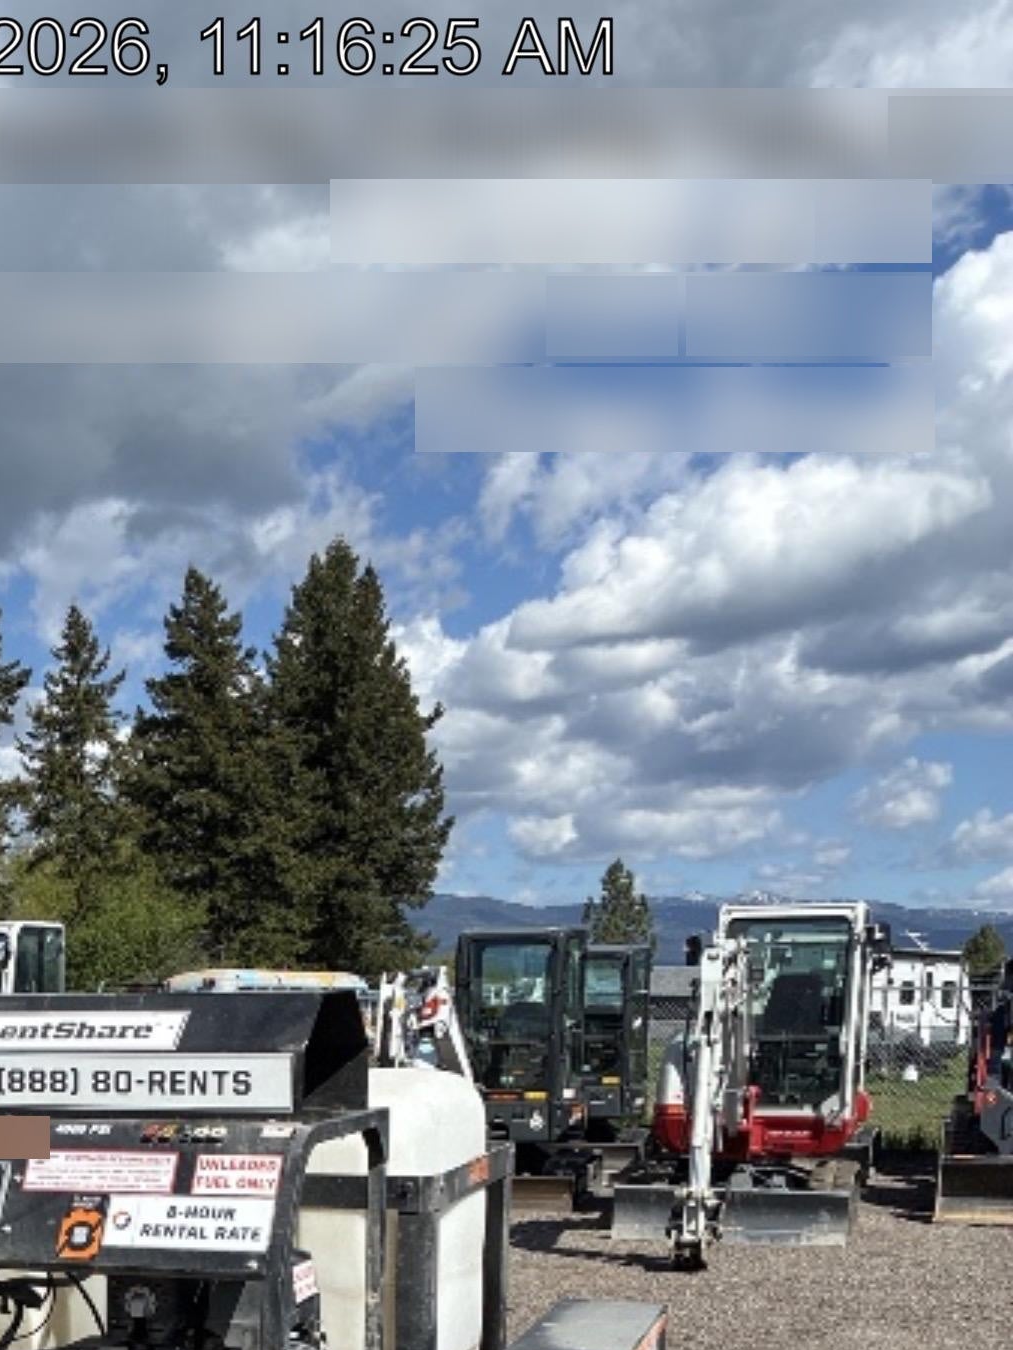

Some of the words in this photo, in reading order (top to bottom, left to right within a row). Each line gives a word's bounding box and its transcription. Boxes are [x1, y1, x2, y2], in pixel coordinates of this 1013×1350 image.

[92, 1070, 253, 1096] 80-RENTS
[199, 1158, 277, 1172] UNLEADED
[196, 1175, 230, 1189] FUEL
[236, 1178, 277, 1192] ONLY
[167, 1205, 236, 1220] 8-HOUR
[140, 1223, 208, 1240] RENTAL
[214, 1226, 262, 1242] RATE
